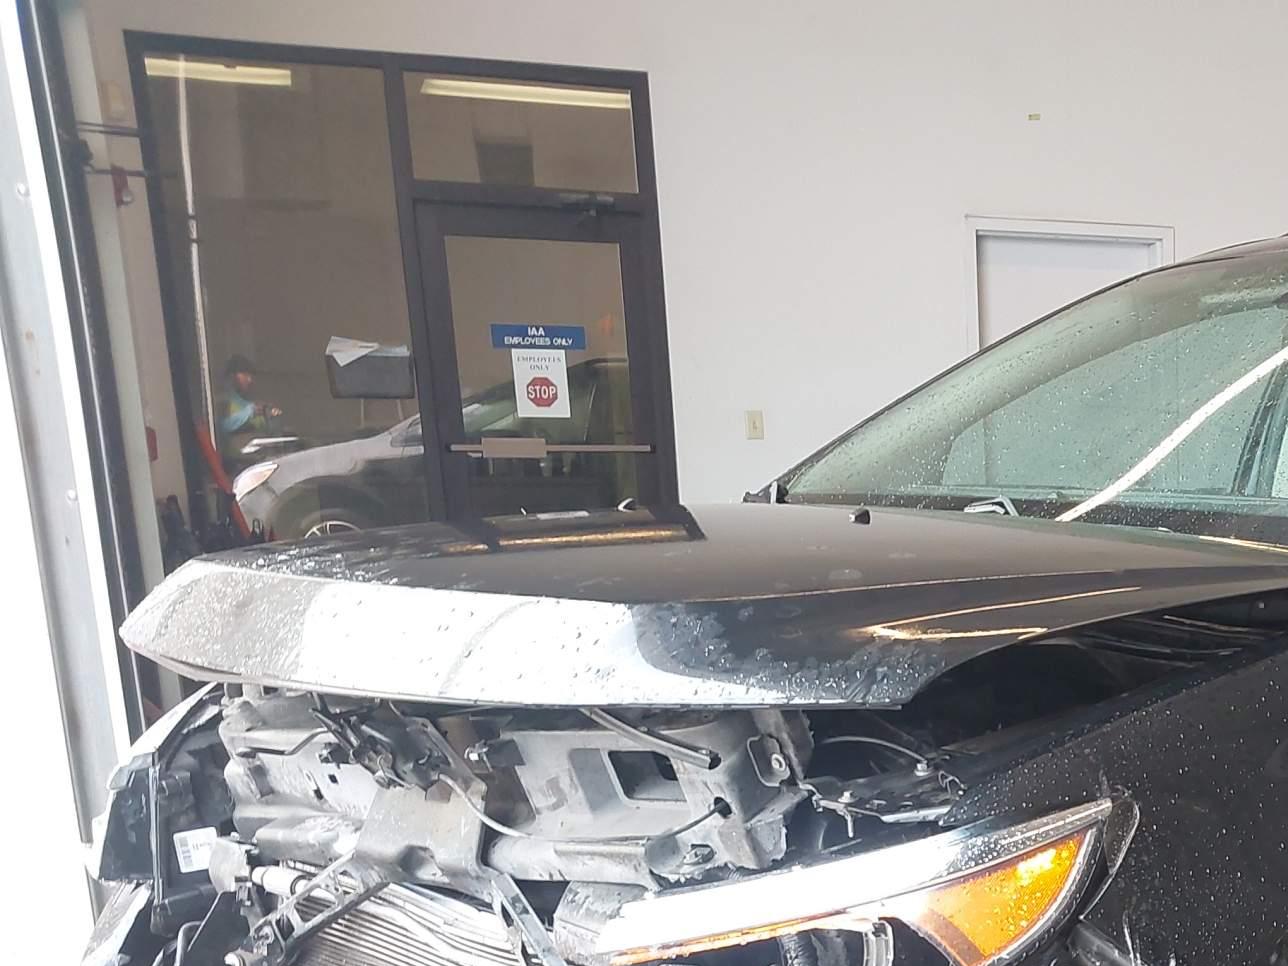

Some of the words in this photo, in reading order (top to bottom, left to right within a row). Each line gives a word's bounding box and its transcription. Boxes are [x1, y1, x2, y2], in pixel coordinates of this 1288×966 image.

[528, 326, 545, 336] IAA
[504, 336, 551, 346] EMPLOYEES
[552, 338, 573, 346] ONLY
[528, 385, 556, 399] STOP
